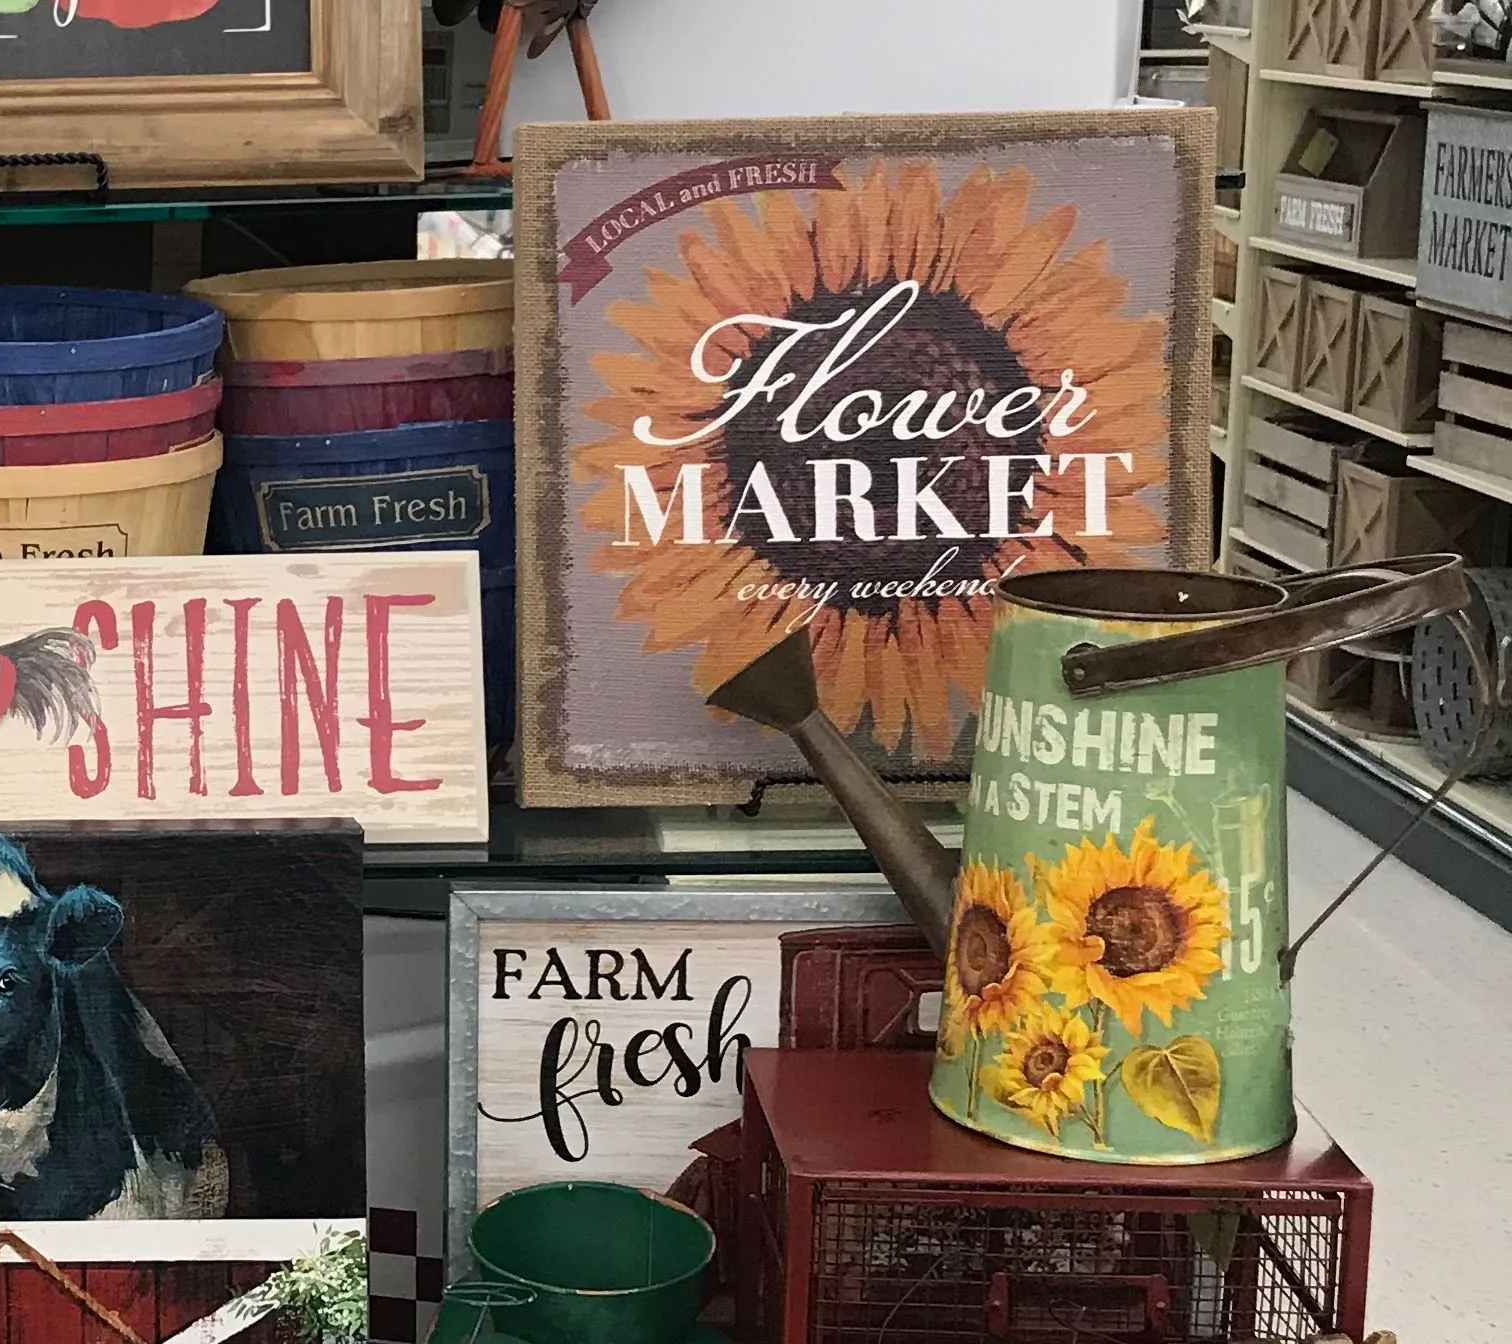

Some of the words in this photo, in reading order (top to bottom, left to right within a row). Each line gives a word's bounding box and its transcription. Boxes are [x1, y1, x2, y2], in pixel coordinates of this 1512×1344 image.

[584, 191, 675, 254] LOCAL
[679, 173, 721, 204] and
[727, 162, 817, 190] FRESH
[1428, 210, 1512, 281] MARKET
[633, 279, 1097, 446] Flower
[279, 500, 359, 532] Farm
[374, 490, 468, 526] Fresh
[611, 452, 1133, 547] MARKET
[737, 569, 839, 634] every
[850, 546, 1027, 599] weekend
[64, 593, 444, 802] SHINE
[975, 691, 1219, 776] UNSHINE
[983, 780, 1000, 817] A
[1006, 771, 1123, 834] STEM
[491, 946, 695, 1001] FARM
[478, 975, 753, 1163] fresh
